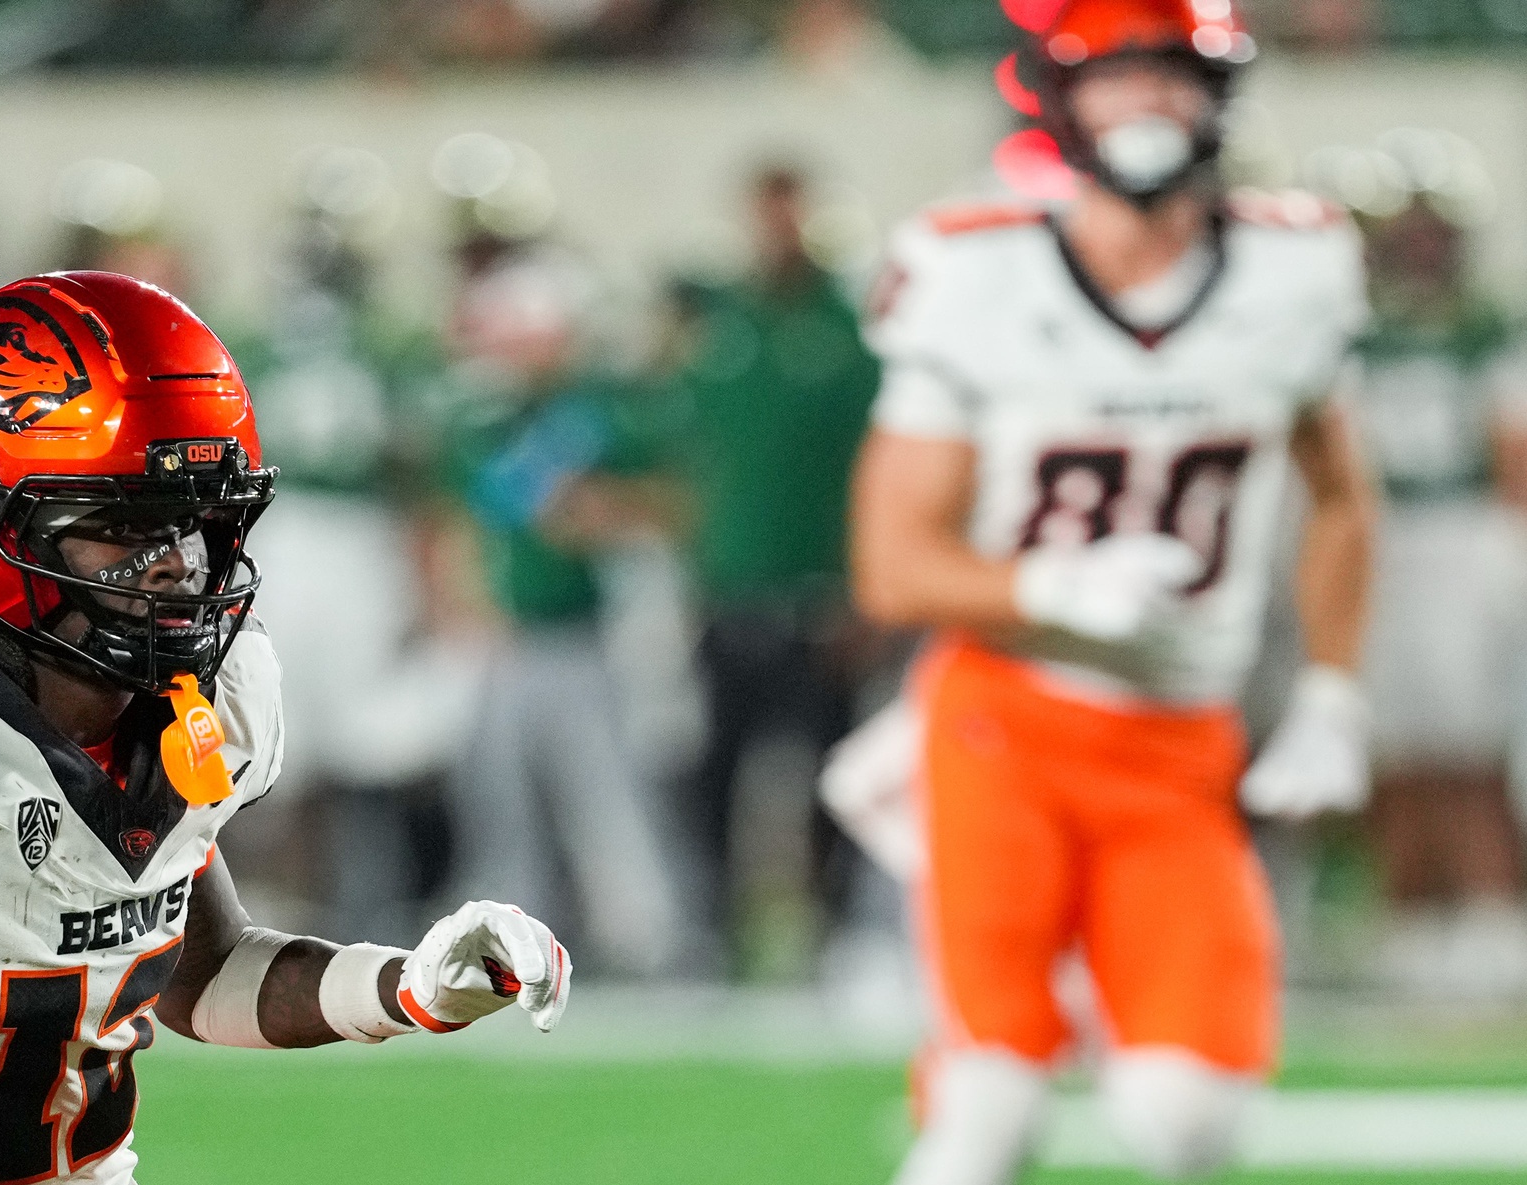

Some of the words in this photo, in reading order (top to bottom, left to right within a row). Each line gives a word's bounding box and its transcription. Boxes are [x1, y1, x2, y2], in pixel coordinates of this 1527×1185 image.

[187, 444, 223, 463] OSU
[99, 543, 171, 583] Problem
[17, 797, 61, 843] PAC
[27, 845, 43, 860] 12
[56, 873, 191, 956] BEAVS
